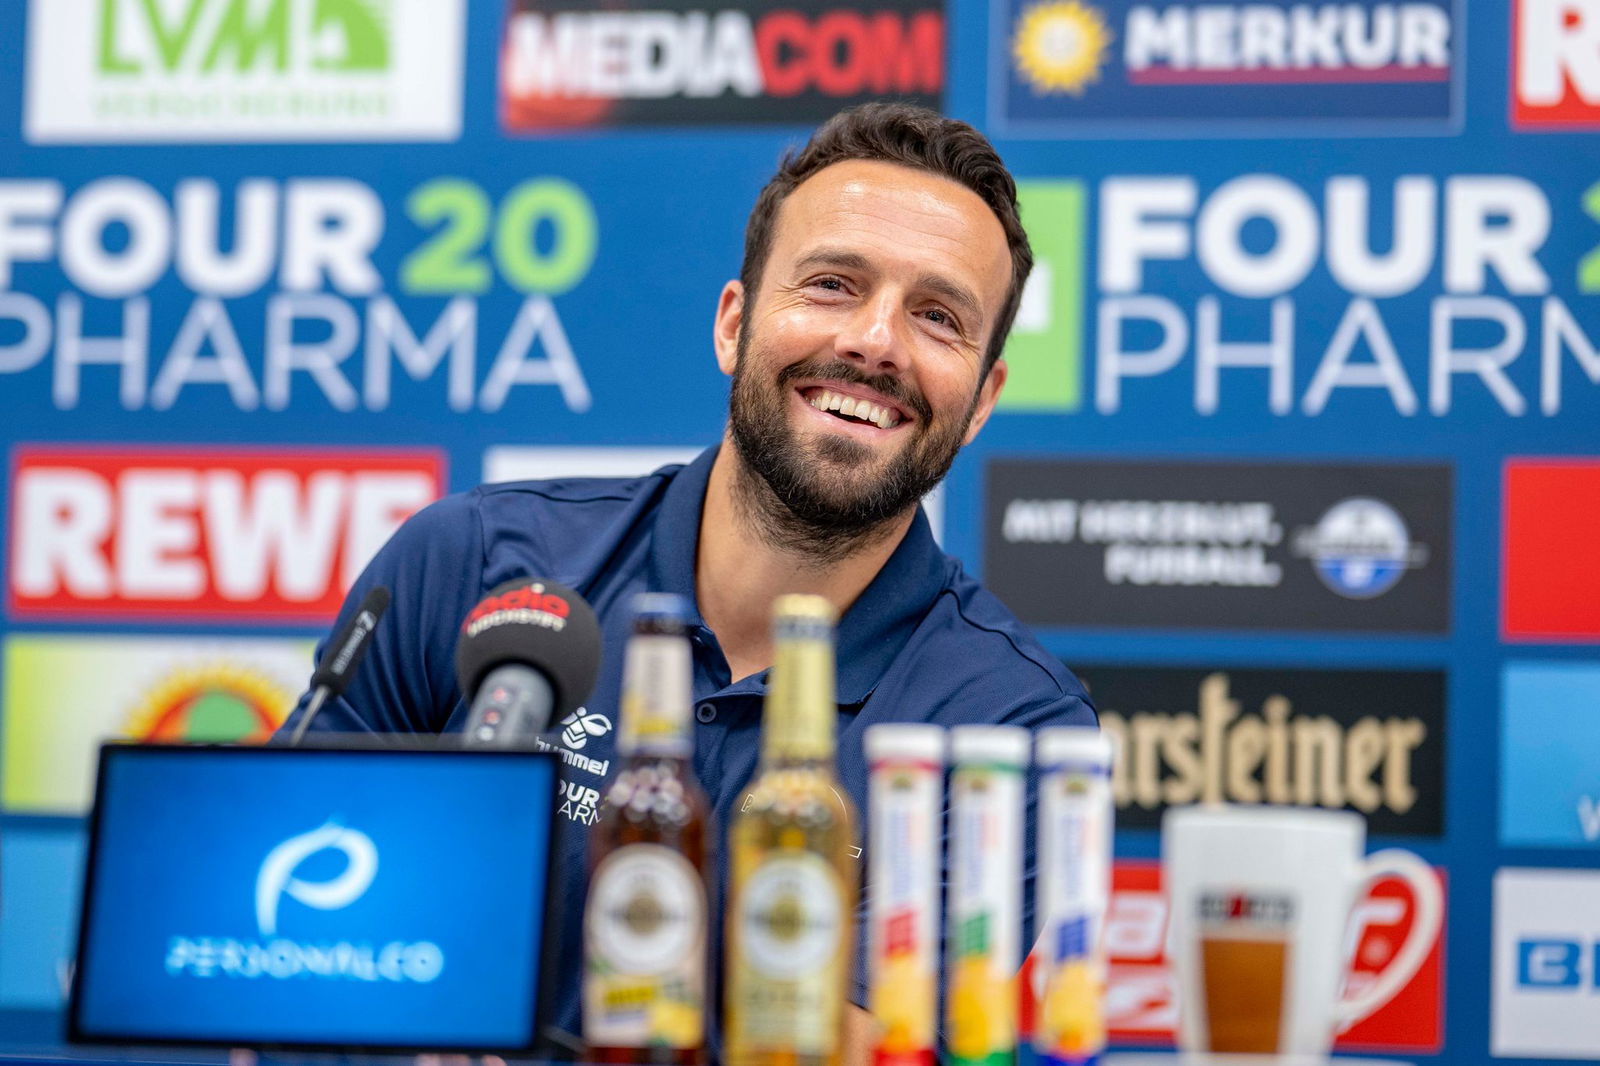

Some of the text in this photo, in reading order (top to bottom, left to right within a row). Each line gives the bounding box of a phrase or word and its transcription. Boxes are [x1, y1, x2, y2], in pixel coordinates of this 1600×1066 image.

[506, 11, 944, 97] MEDIACOM
[1125, 3, 1451, 70] MERKUR
[399, 176, 598, 296] 20
[1099, 174, 1552, 298] FOUR
[1100, 673, 1427, 813] arsteiner
